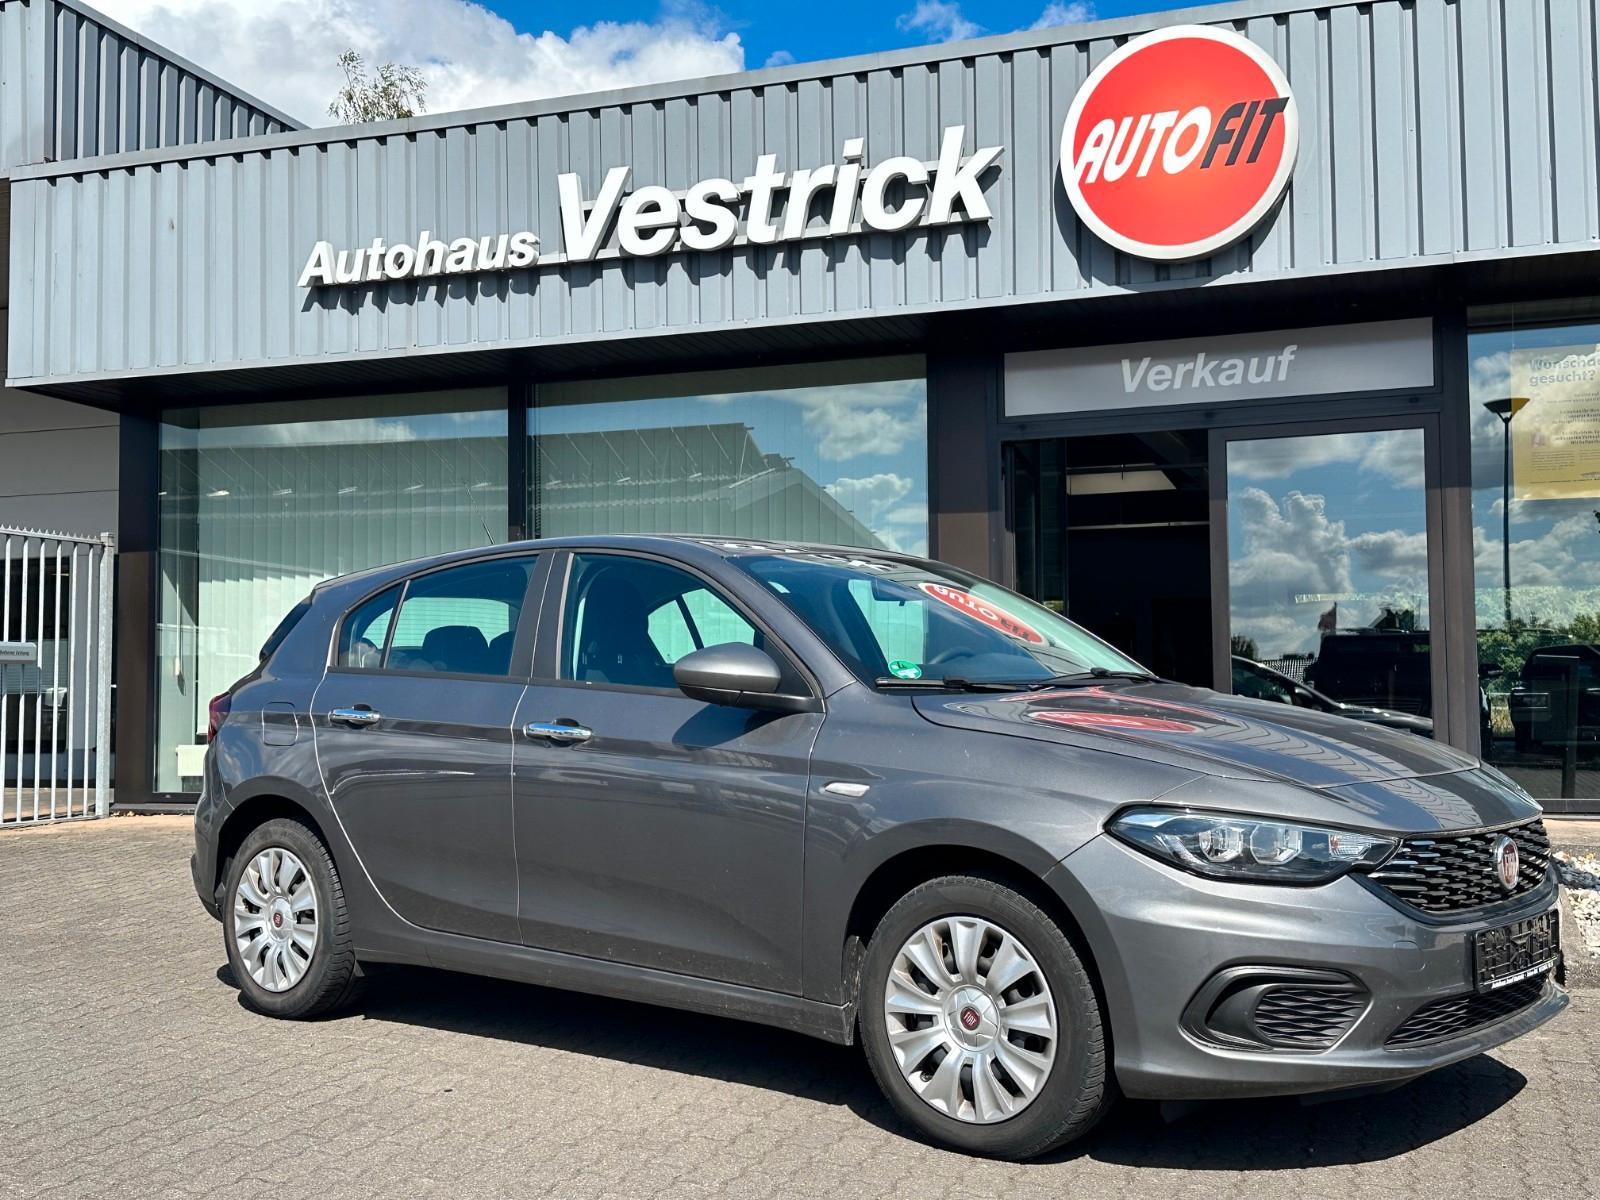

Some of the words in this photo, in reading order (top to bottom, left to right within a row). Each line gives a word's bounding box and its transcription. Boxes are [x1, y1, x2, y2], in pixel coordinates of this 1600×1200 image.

[298, 231, 541, 288] Autohaus
[557, 125, 1004, 262] Vestrick
[1121, 345, 1298, 393] Verkauf
[1529, 370, 1596, 387] gesucht?
